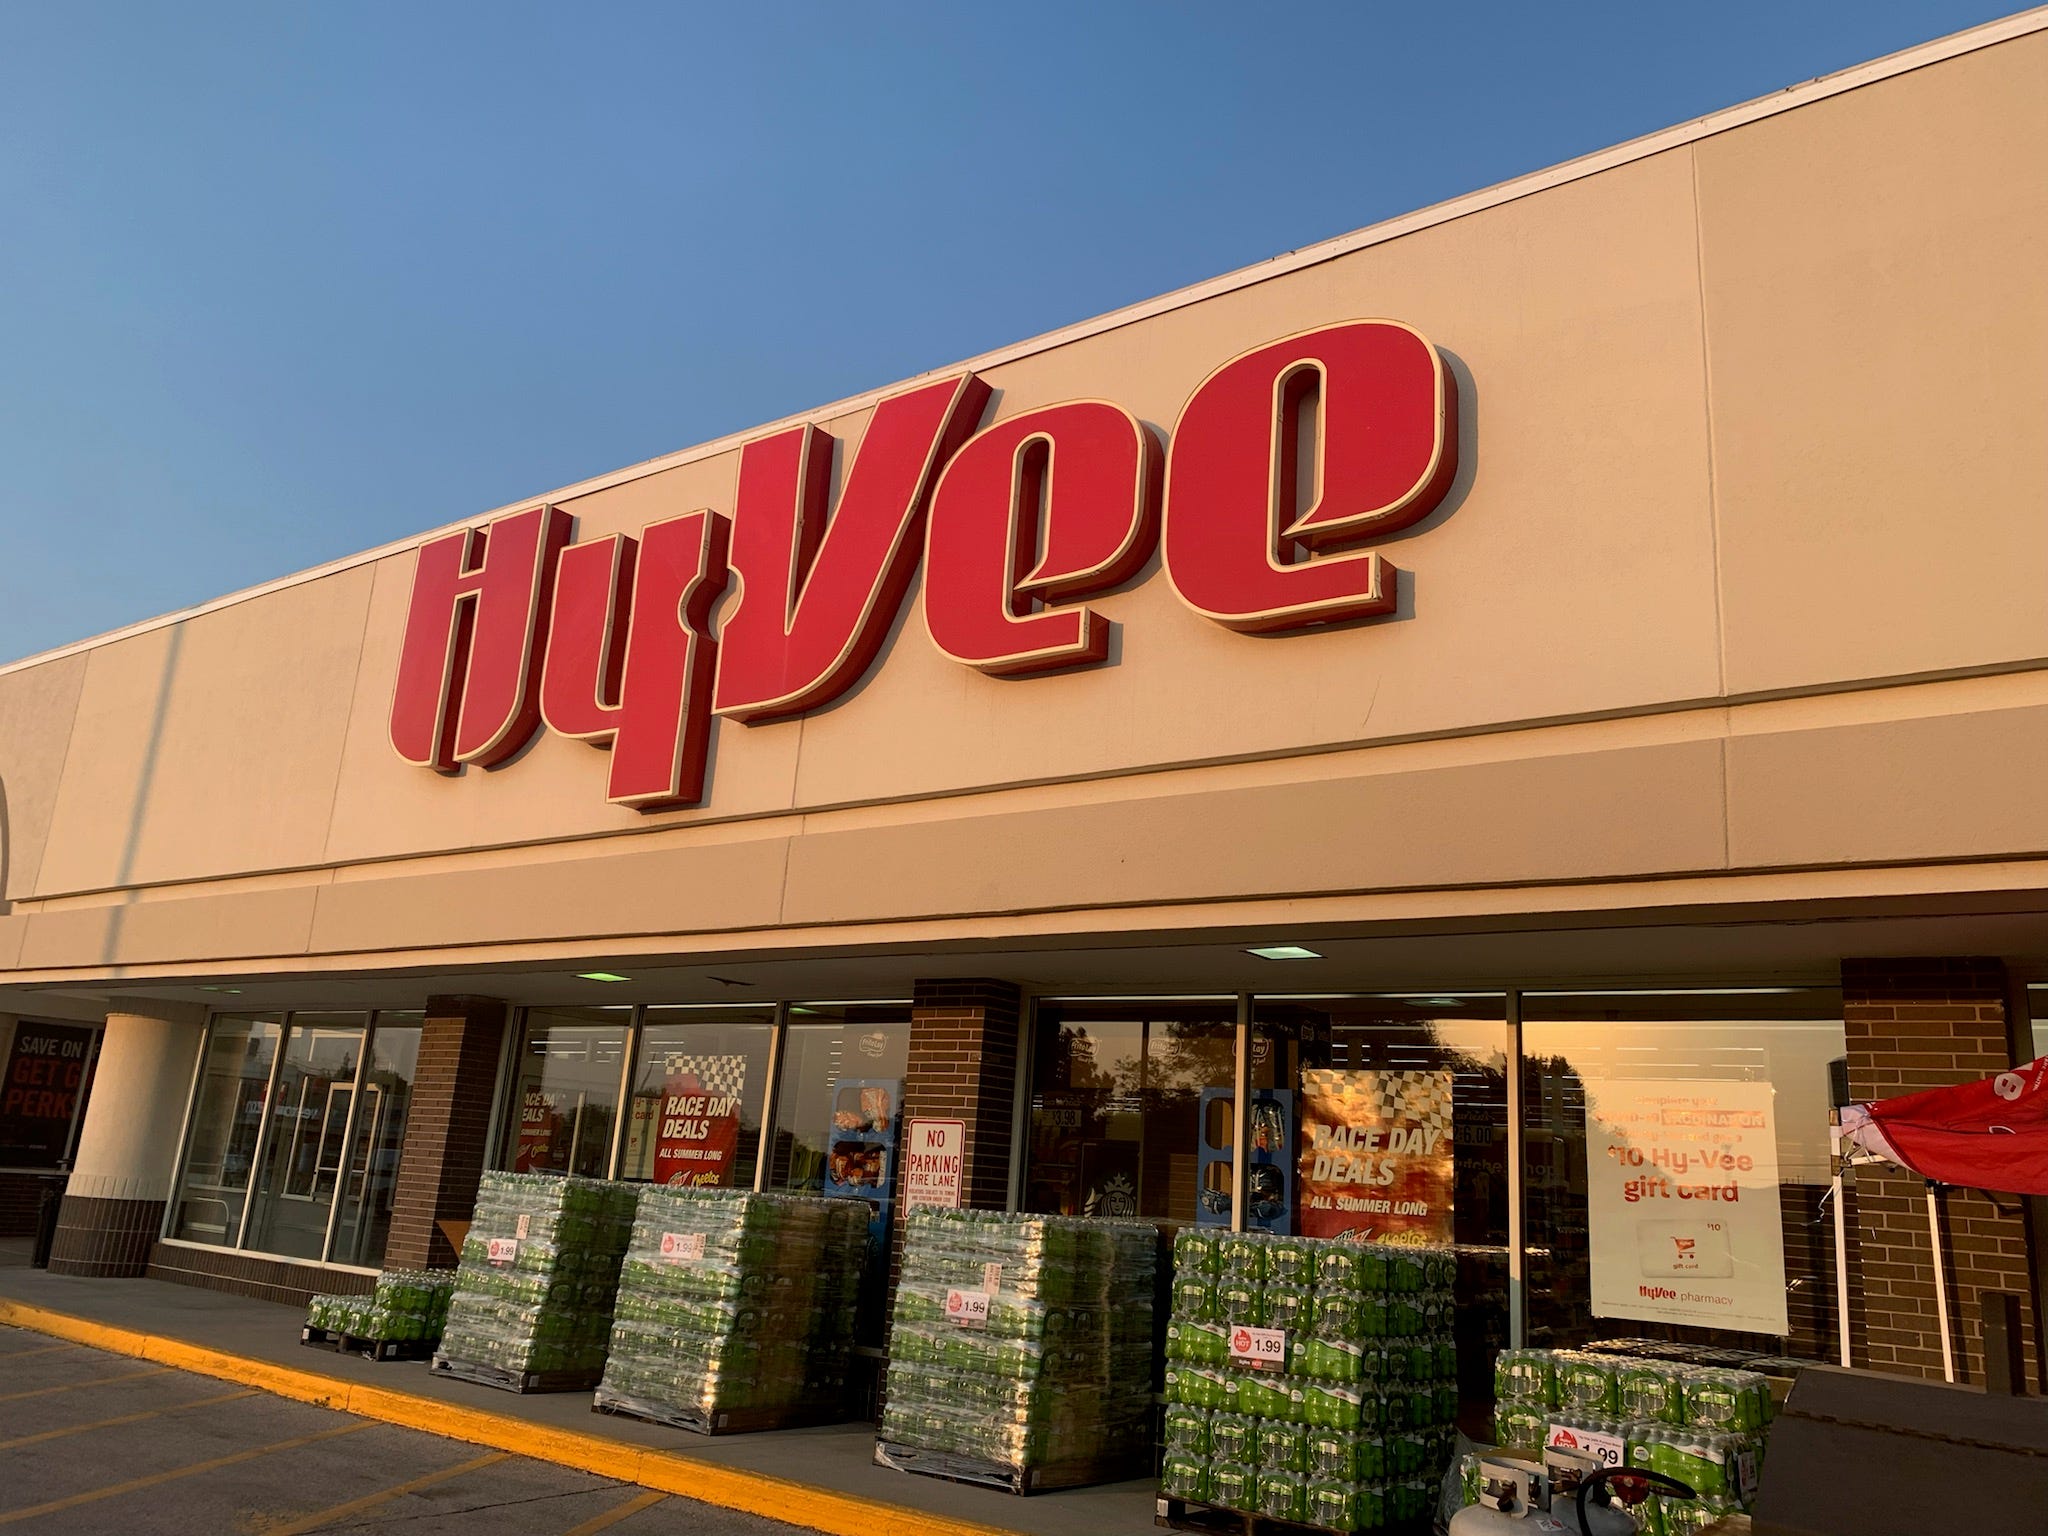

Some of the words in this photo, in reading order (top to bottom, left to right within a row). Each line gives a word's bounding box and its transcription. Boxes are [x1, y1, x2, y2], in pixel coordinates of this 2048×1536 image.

[390, 318, 1457, 810] HyVee
[20, 1036, 59, 1056] SAVE
[61, 1040, 84, 1058] ON
[13, 1057, 60, 1087] GET
[522, 1108, 544, 1122] EALS
[665, 1096, 705, 1116] RACE
[706, 1097, 736, 1117] DAY
[662, 1119, 710, 1140] DEALS
[927, 1130, 945, 1148] NO
[1312, 1124, 1380, 1153] RACE
[1387, 1127, 1441, 1155] DAY
[659, 1148, 671, 1159] ALL
[673, 1148, 703, 1160] SUMMER
[704, 1150, 723, 1161] LONG
[910, 1154, 959, 1174] PARKING
[1652, 1148, 1754, 1174] Hy-Vee
[910, 1173, 929, 1186] FIRE
[933, 1174, 956, 1187] LANE
[1312, 1156, 1396, 1186] DEALS
[1624, 1175, 1671, 1203] gift
[1677, 1180, 1740, 1203] card
[1310, 1195, 1332, 1210] ALL
[1336, 1197, 1391, 1214] SUMMER
[1394, 1201, 1429, 1217] LONG
[1639, 1285, 1677, 1301] HyVee
[1680, 1292, 1734, 1306] pharmacy
[965, 1301, 986, 1313] 1.99
[1255, 1339, 1281, 1353] 1.99
